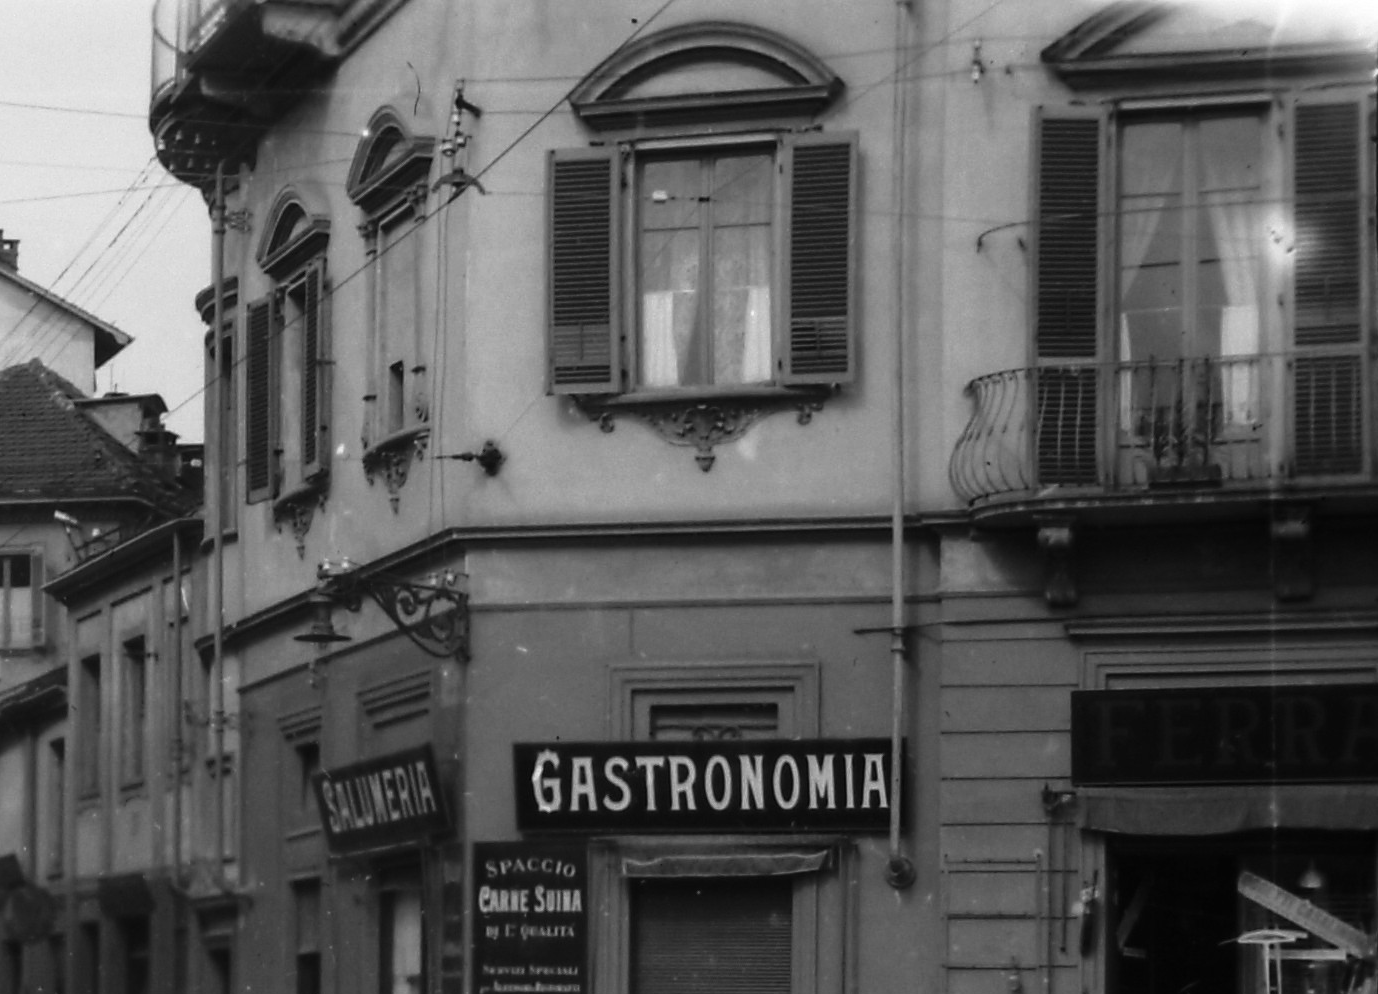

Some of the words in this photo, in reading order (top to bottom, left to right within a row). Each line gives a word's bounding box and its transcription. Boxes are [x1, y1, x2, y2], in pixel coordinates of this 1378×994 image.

[322, 760, 437, 834] SALUMERIA
[532, 749, 889, 814] GASTRONOMIA
[484, 857, 577, 878] SPACCIO
[479, 885, 529, 913] CARNE
[534, 885, 582, 912] SUINA
